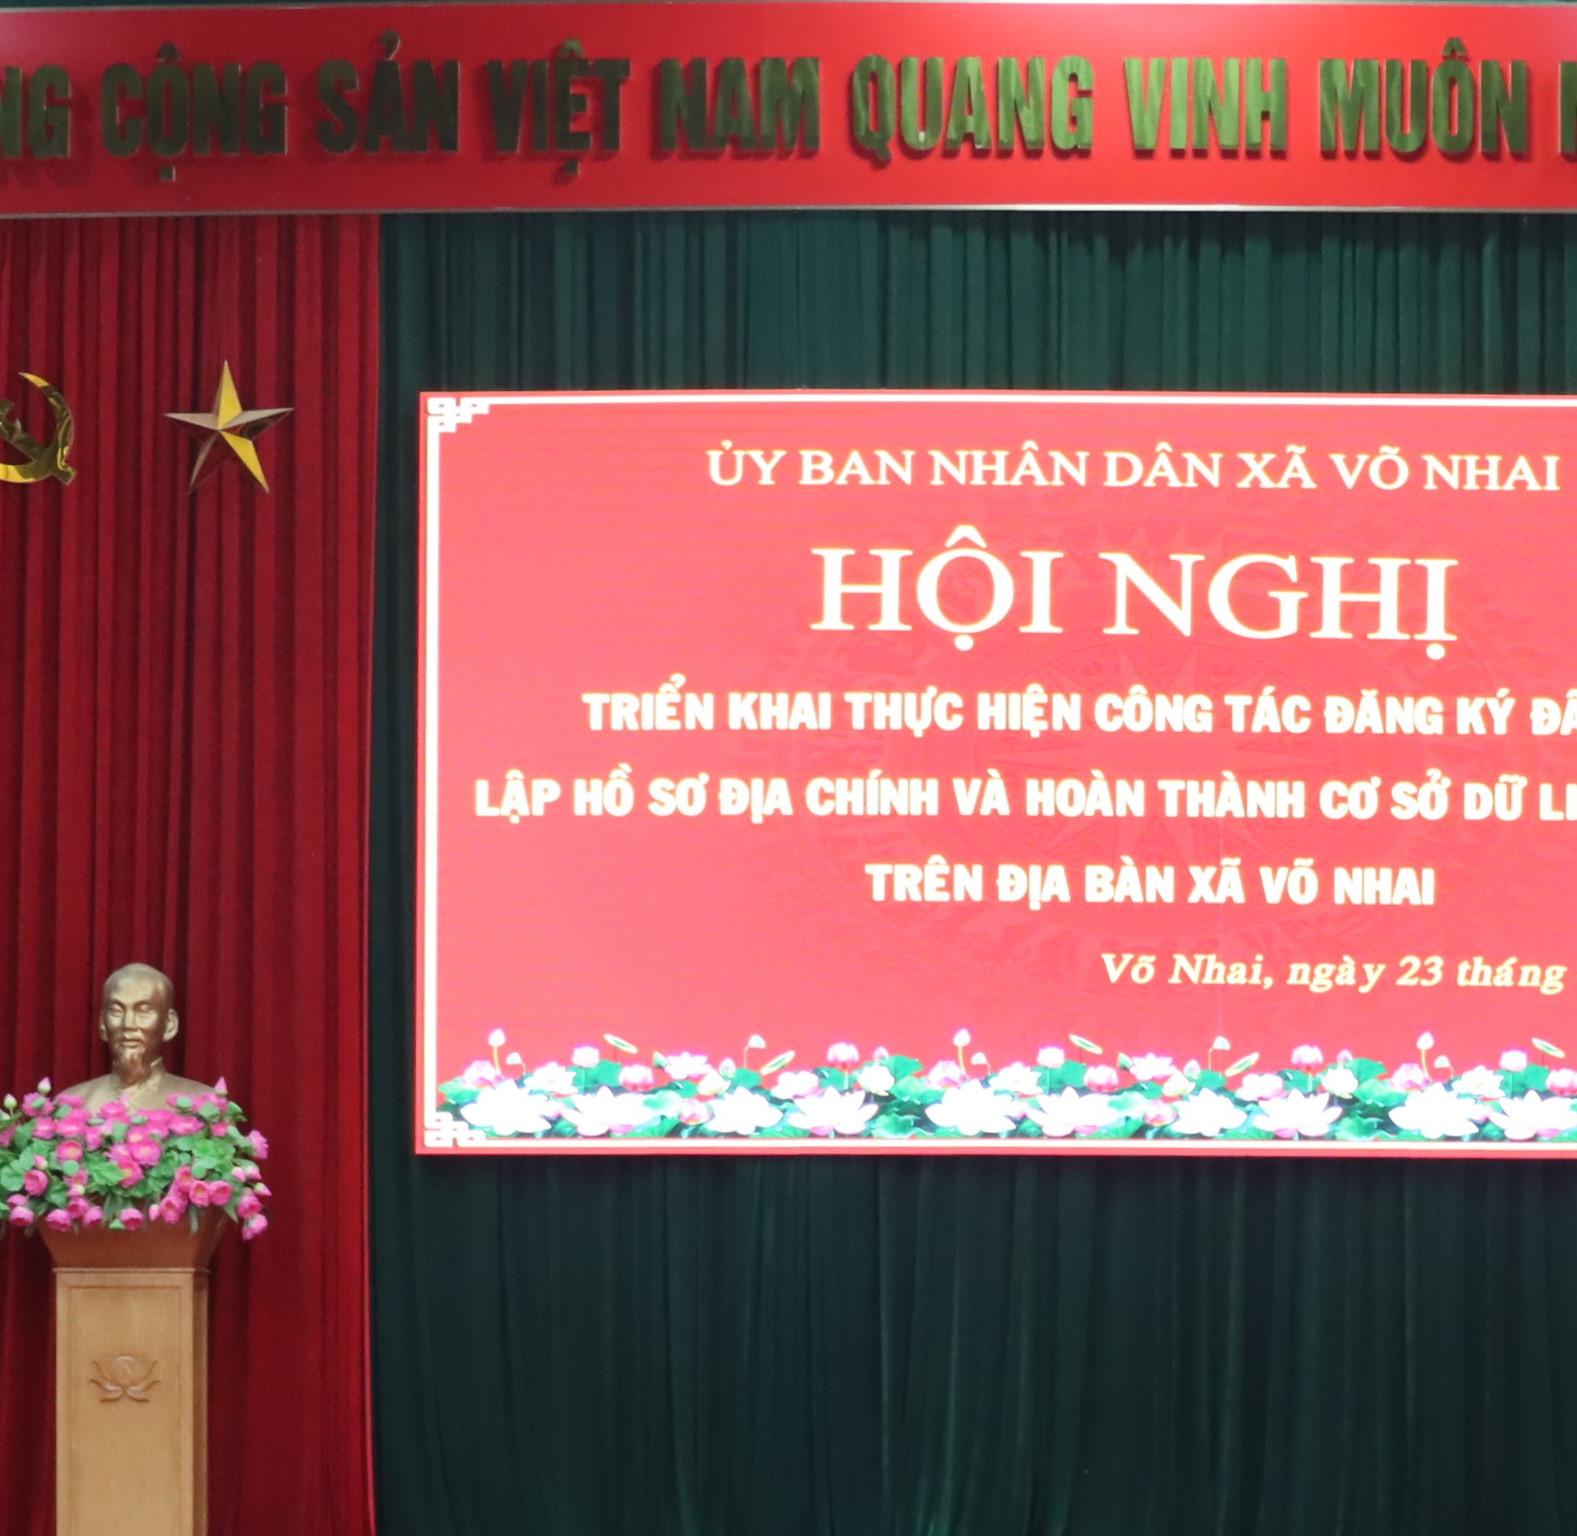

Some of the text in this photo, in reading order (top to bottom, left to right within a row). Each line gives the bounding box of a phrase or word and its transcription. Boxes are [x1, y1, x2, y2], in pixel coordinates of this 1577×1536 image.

[100, 43, 289, 182] CỘNG
[316, 29, 460, 155] SẢN
[485, 37, 631, 176] VIỆT
[659, 56, 821, 155] NAM
[849, 54, 1094, 164] QUANG
[1122, 56, 1289, 155] VINH
[1319, 38, 1529, 156] MUÔN
[707, 441, 1559, 490] ỦY BAN NHÂN DÂN XÃ VÕ NHAI
[811, 526, 1458, 659] HỘI NGHỊ
[582, 674, 714, 730] TRIỂN
[729, 692, 831, 729] KHAI
[844, 686, 963, 737] THỰC
[978, 684, 1081, 738] HIỆN
[1094, 685, 1213, 732] CÔNG
[1224, 686, 1311, 733] TÁC
[1324, 690, 1443, 734] ĐĂNG
[1457, 688, 1515, 734] KÝ
[475, 770, 561, 824] LẬP
[574, 763, 634, 816] HỒ
[648, 773, 709, 816] SƠ
[718, 778, 793, 824] ĐỊA
[806, 769, 938, 816] CHÍNH
[953, 769, 1010, 815] VÀ
[1026, 770, 1145, 817] HOÀN
[1158, 771, 1305, 818] THÀNH
[1320, 777, 1381, 819] CƠ
[1391, 768, 1451, 820] SỞ
[1464, 774, 1527, 820] DỮ
[865, 855, 1435, 910] TRÊN ĐỊA BÀN XÃ VÕ NHAI
[1102, 954, 1155, 983] Võ
[1169, 954, 1273, 989] Nhai,
[1287, 956, 1385, 993] ngày
[1396, 956, 1443, 986] 23
[1457, 957, 1566, 995] tháng
